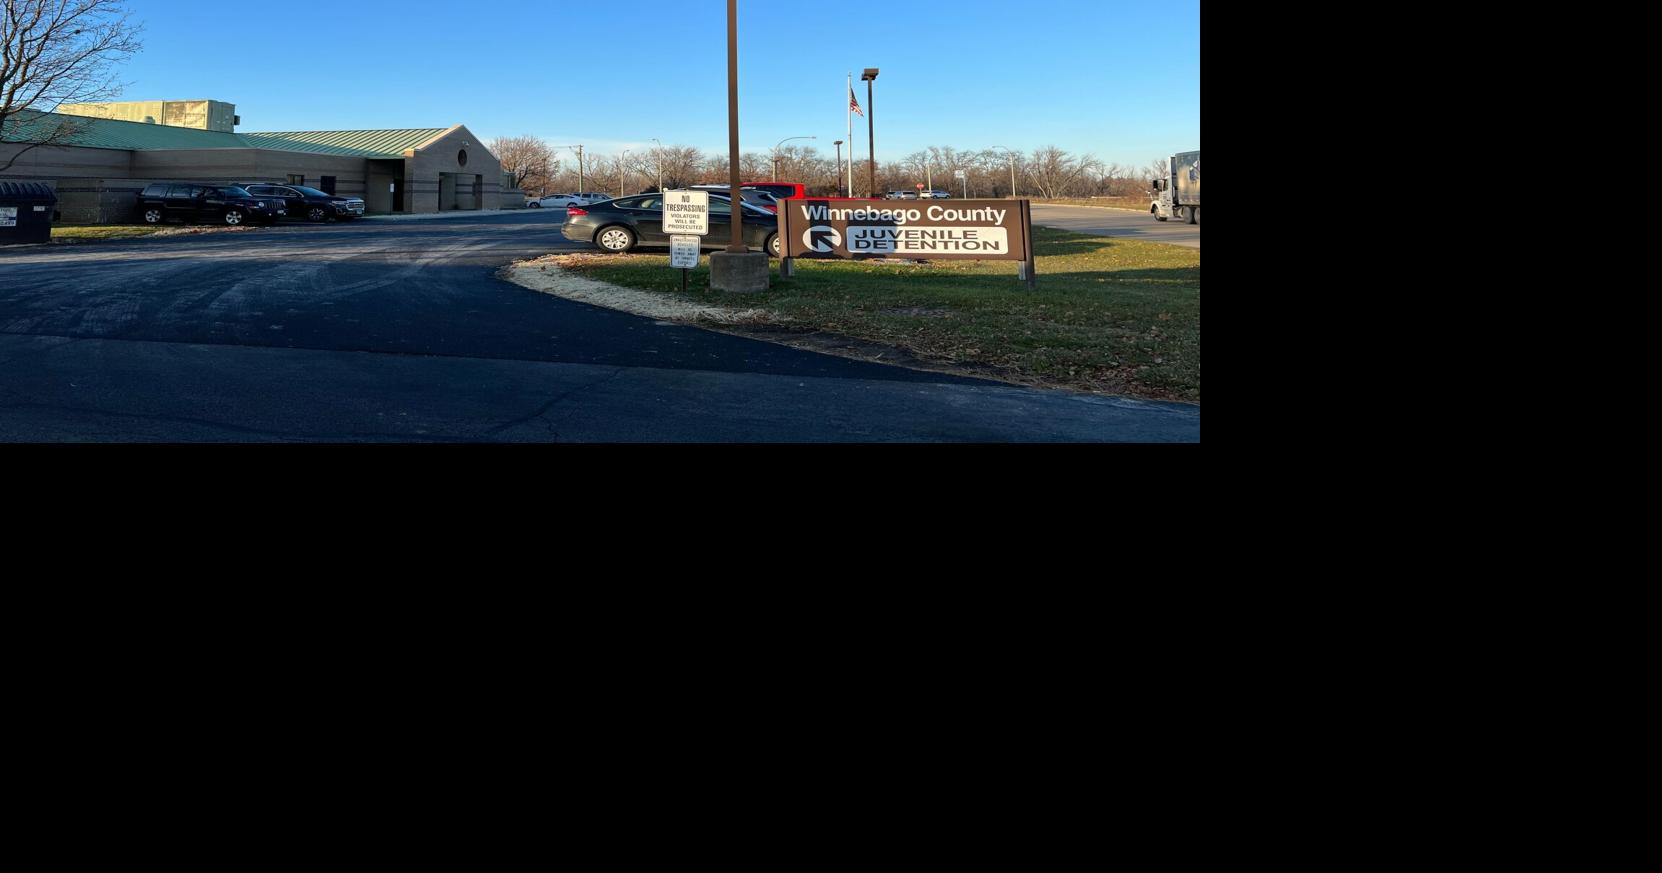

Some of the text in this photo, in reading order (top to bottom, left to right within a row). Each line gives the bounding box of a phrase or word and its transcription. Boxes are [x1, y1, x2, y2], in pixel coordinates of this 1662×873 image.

[681, 195, 690, 203] NO
[666, 204, 706, 213] TRESPASSING
[801, 205, 1006, 225] Winnebago County
[854, 229, 978, 239] JUVENILE
[855, 240, 1000, 250] DETENTION
